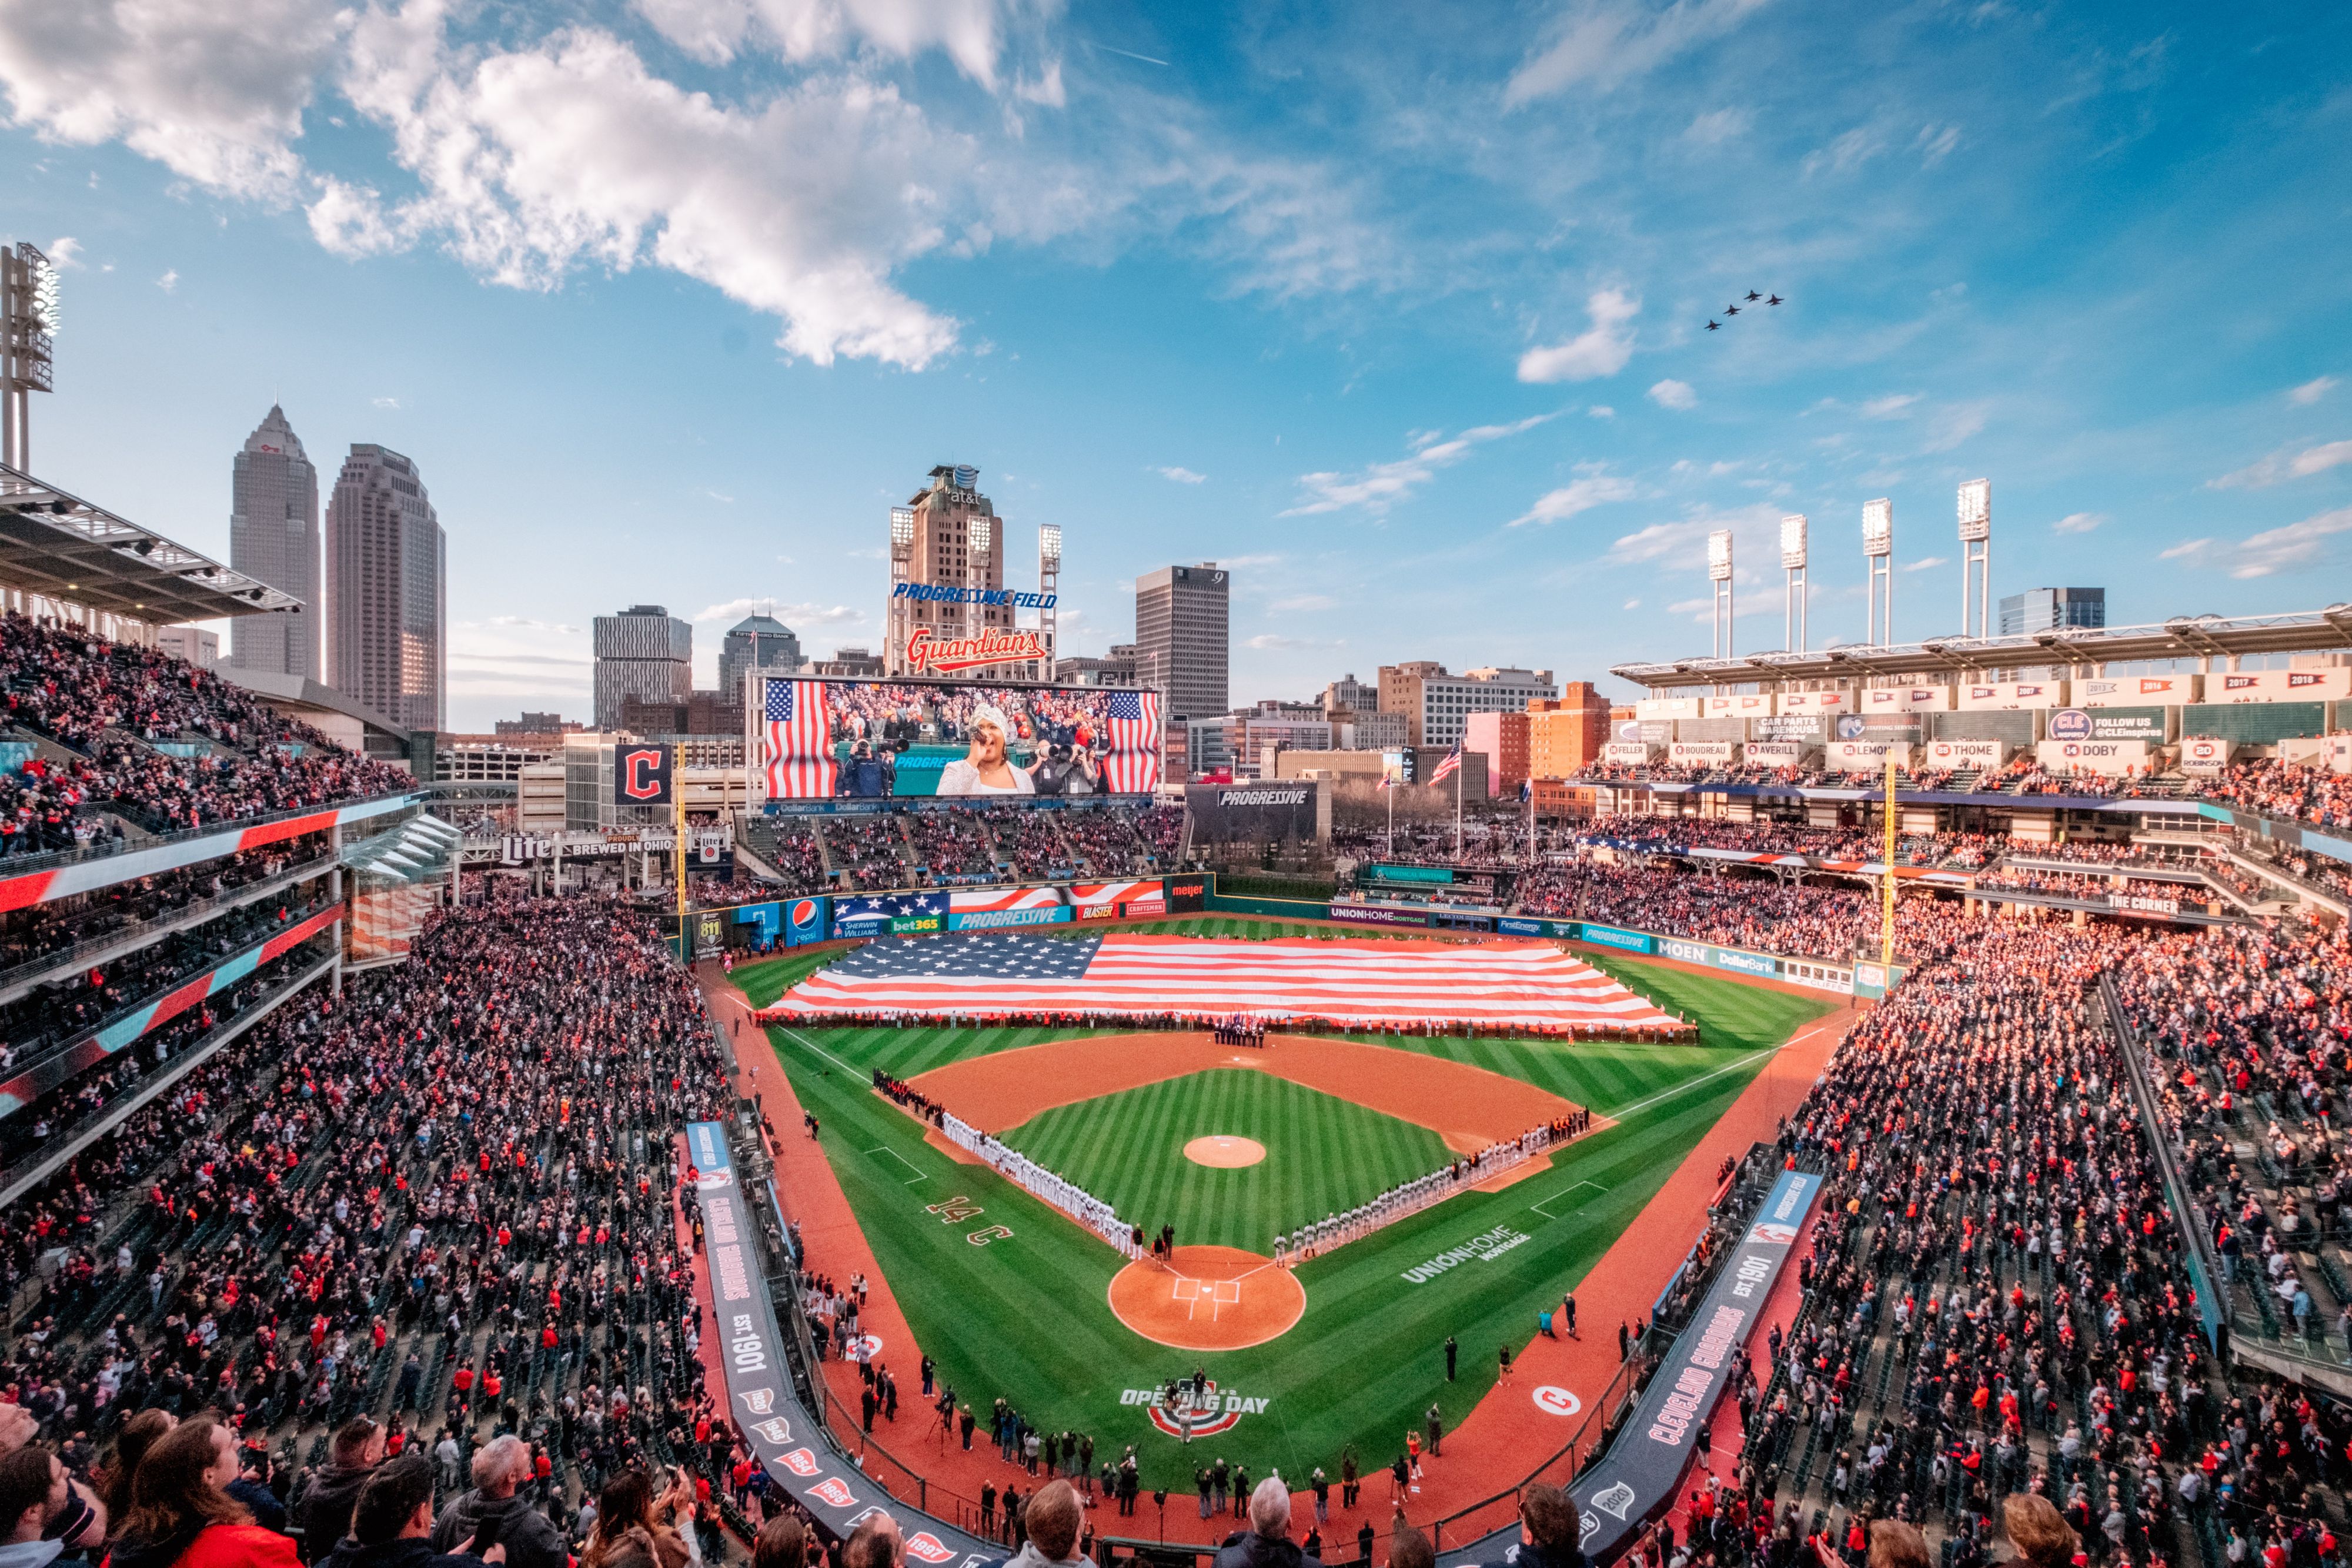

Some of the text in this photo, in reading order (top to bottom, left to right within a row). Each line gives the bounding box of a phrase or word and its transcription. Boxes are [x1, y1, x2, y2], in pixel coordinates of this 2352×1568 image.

[951, 492, 980, 505] at&t
[1212, 571, 1224, 584] 9
[893, 583, 1057, 609] PROGRESSIVE FIELD
[906, 627, 1046, 673] Guardians
[2143, 682, 2162, 690] 2016
[2228, 678, 2249, 687] 2017
[2291, 676, 2314, 684] 2018
[1973, 689, 1988, 697] 2001
[2018, 687, 2034, 696] 2007
[2089, 684, 2106, 693] 2013
[1760, 717, 1817, 726] CAR PARTS
[2057, 716, 2084, 729] CLE
[2096, 717, 2151, 728] FOLLOW US
[1758, 725, 1820, 734] WAREHOUSE
[2096, 727, 2163, 738] @CLEinspires
[1686, 746, 1726, 754] BOUDREAU
[1760, 746, 1795, 755] AVERILL
[1857, 745, 1890, 755] LEMON
[1937, 745, 1993, 755] 25 THOME
[2066, 745, 2119, 756] 14 DOBY
[2196, 746, 2211, 755] 20
[894, 757, 963, 768] PROGRE
[624, 749, 662, 800] C
[1220, 790, 1309, 807] PROGRESSIVE
[780, 803, 824, 812] DollarBank
[608, 834, 640, 842] PROUDLY
[702, 837, 719, 847] Lite
[499, 836, 552, 866] Lite
[573, 840, 672, 855] BREWED IN OHIO
[1389, 870, 1418, 878] MEDICAL
[1172, 885, 1204, 898] meijer
[1129, 904, 1162, 913] CRAFTSMAN
[2109, 895, 2130, 908] THE
[2132, 897, 2179, 914] CORNER
[958, 907, 1059, 930] PROGRESSIVE
[1082, 904, 1113, 920] BLASTER
[700, 920, 720, 938] 811
[846, 921, 878, 930] SHERWIN
[893, 919, 938, 932] bet365
[1501, 920, 1540, 931] FirstEnergy
[795, 931, 816, 944] pepsi
[1586, 928, 1645, 948] PROGRESSIVE
[1658, 941, 1706, 961] MOEN
[1719, 952, 1774, 974] DollarBank
[1859, 967, 1880, 978] drug
[1810, 980, 1844, 991] CLIFFS
[1860, 977, 1883, 986] mart
[925, 1196, 985, 1224] 14
[967, 1225, 1014, 1246] C
[707, 1197, 750, 1301] CLEVELAND GUARDIANS
[1477, 1232, 1531, 1262] MORTGAGE
[1732, 1255, 1772, 1298] EST. 1901
[731, 1313, 767, 1374] EST. 1901
[1649, 1305, 1746, 1446] CLEVELAND GUARDIANS
[751, 1390, 768, 1412] 1920
[1225, 1396, 1270, 1414] DAY
[1542, 1390, 1572, 1410] C
[766, 1420, 786, 1442] 1948
[787, 1450, 812, 1474] 1954
[820, 1480, 847, 1505] 1995
[1602, 1489, 1630, 1511] 2020
[909, 1537, 944, 1559] 1997
